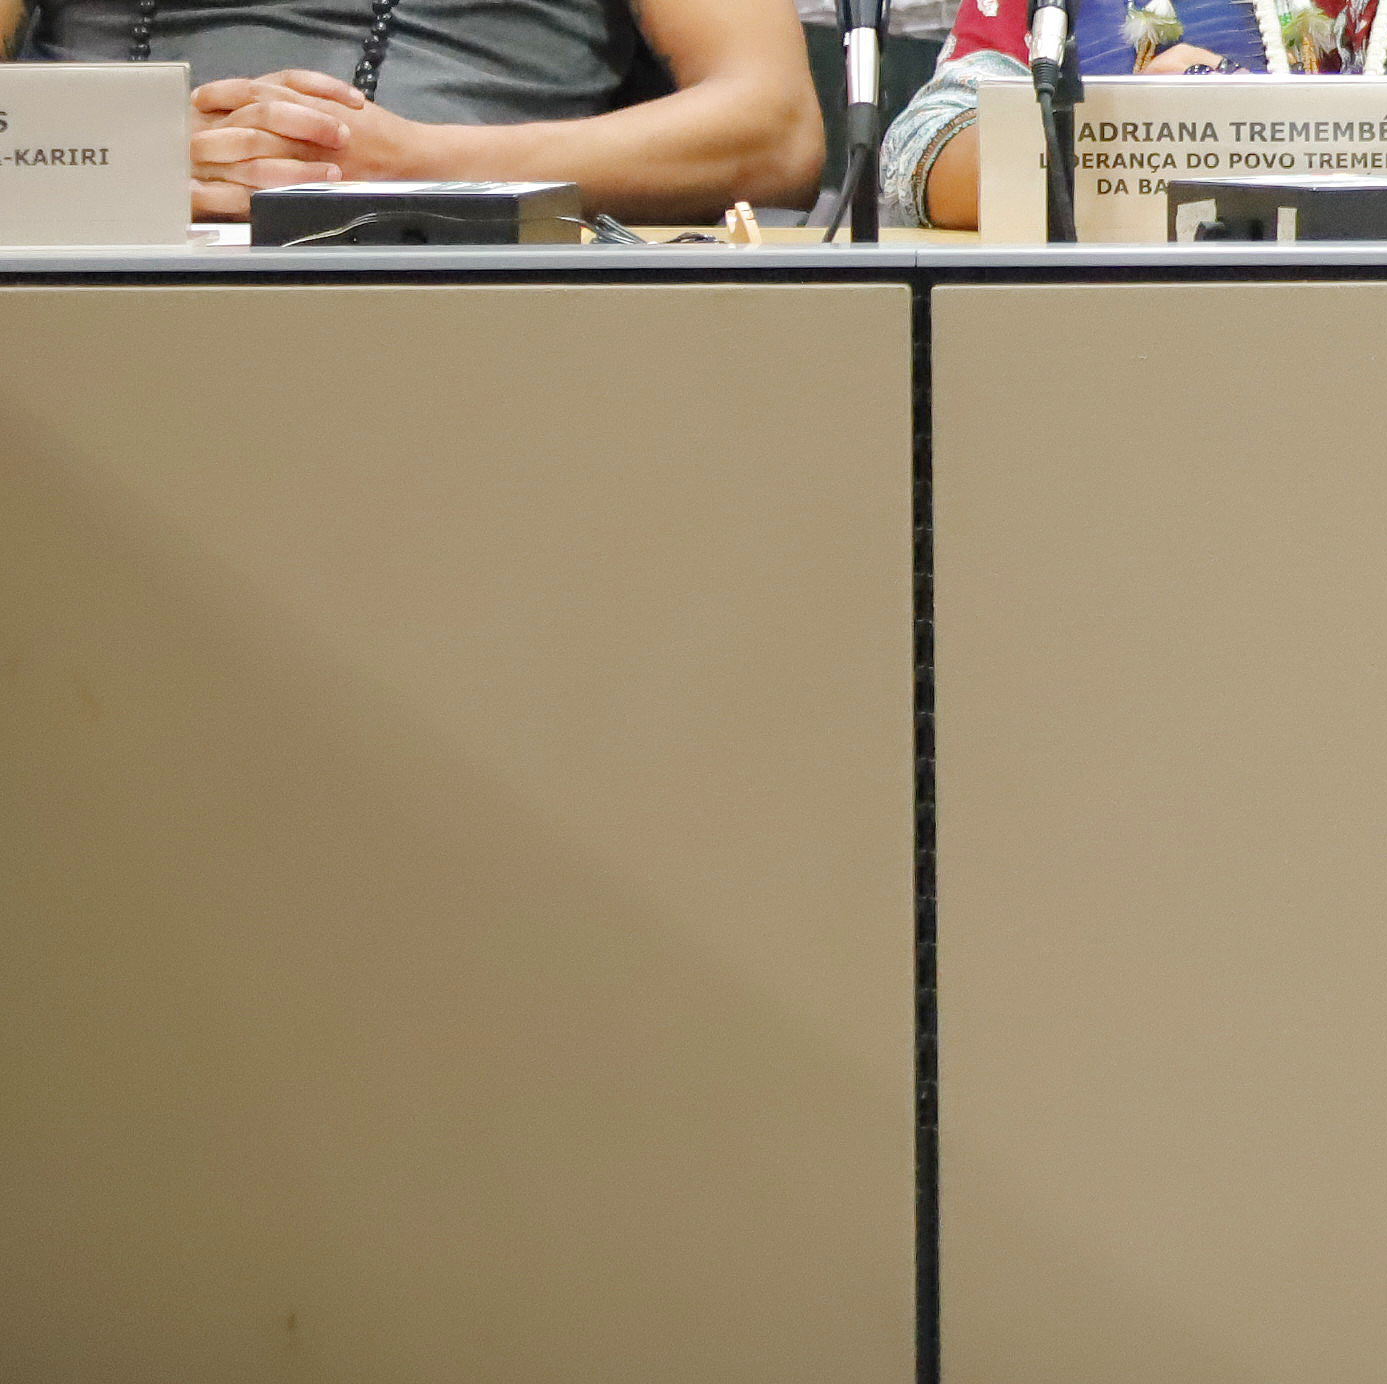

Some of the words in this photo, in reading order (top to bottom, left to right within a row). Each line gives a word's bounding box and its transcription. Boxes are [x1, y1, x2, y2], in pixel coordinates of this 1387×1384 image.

[1077, 121, 1219, 143] ADRIANA
[0, 148, 109, 166] -KARIRI
[1039, 152, 1177, 174] LERANÇA
[1186, 152, 1220, 170] DO
[1229, 152, 1295, 170] POVO
[1096, 178, 1129, 196] DA
